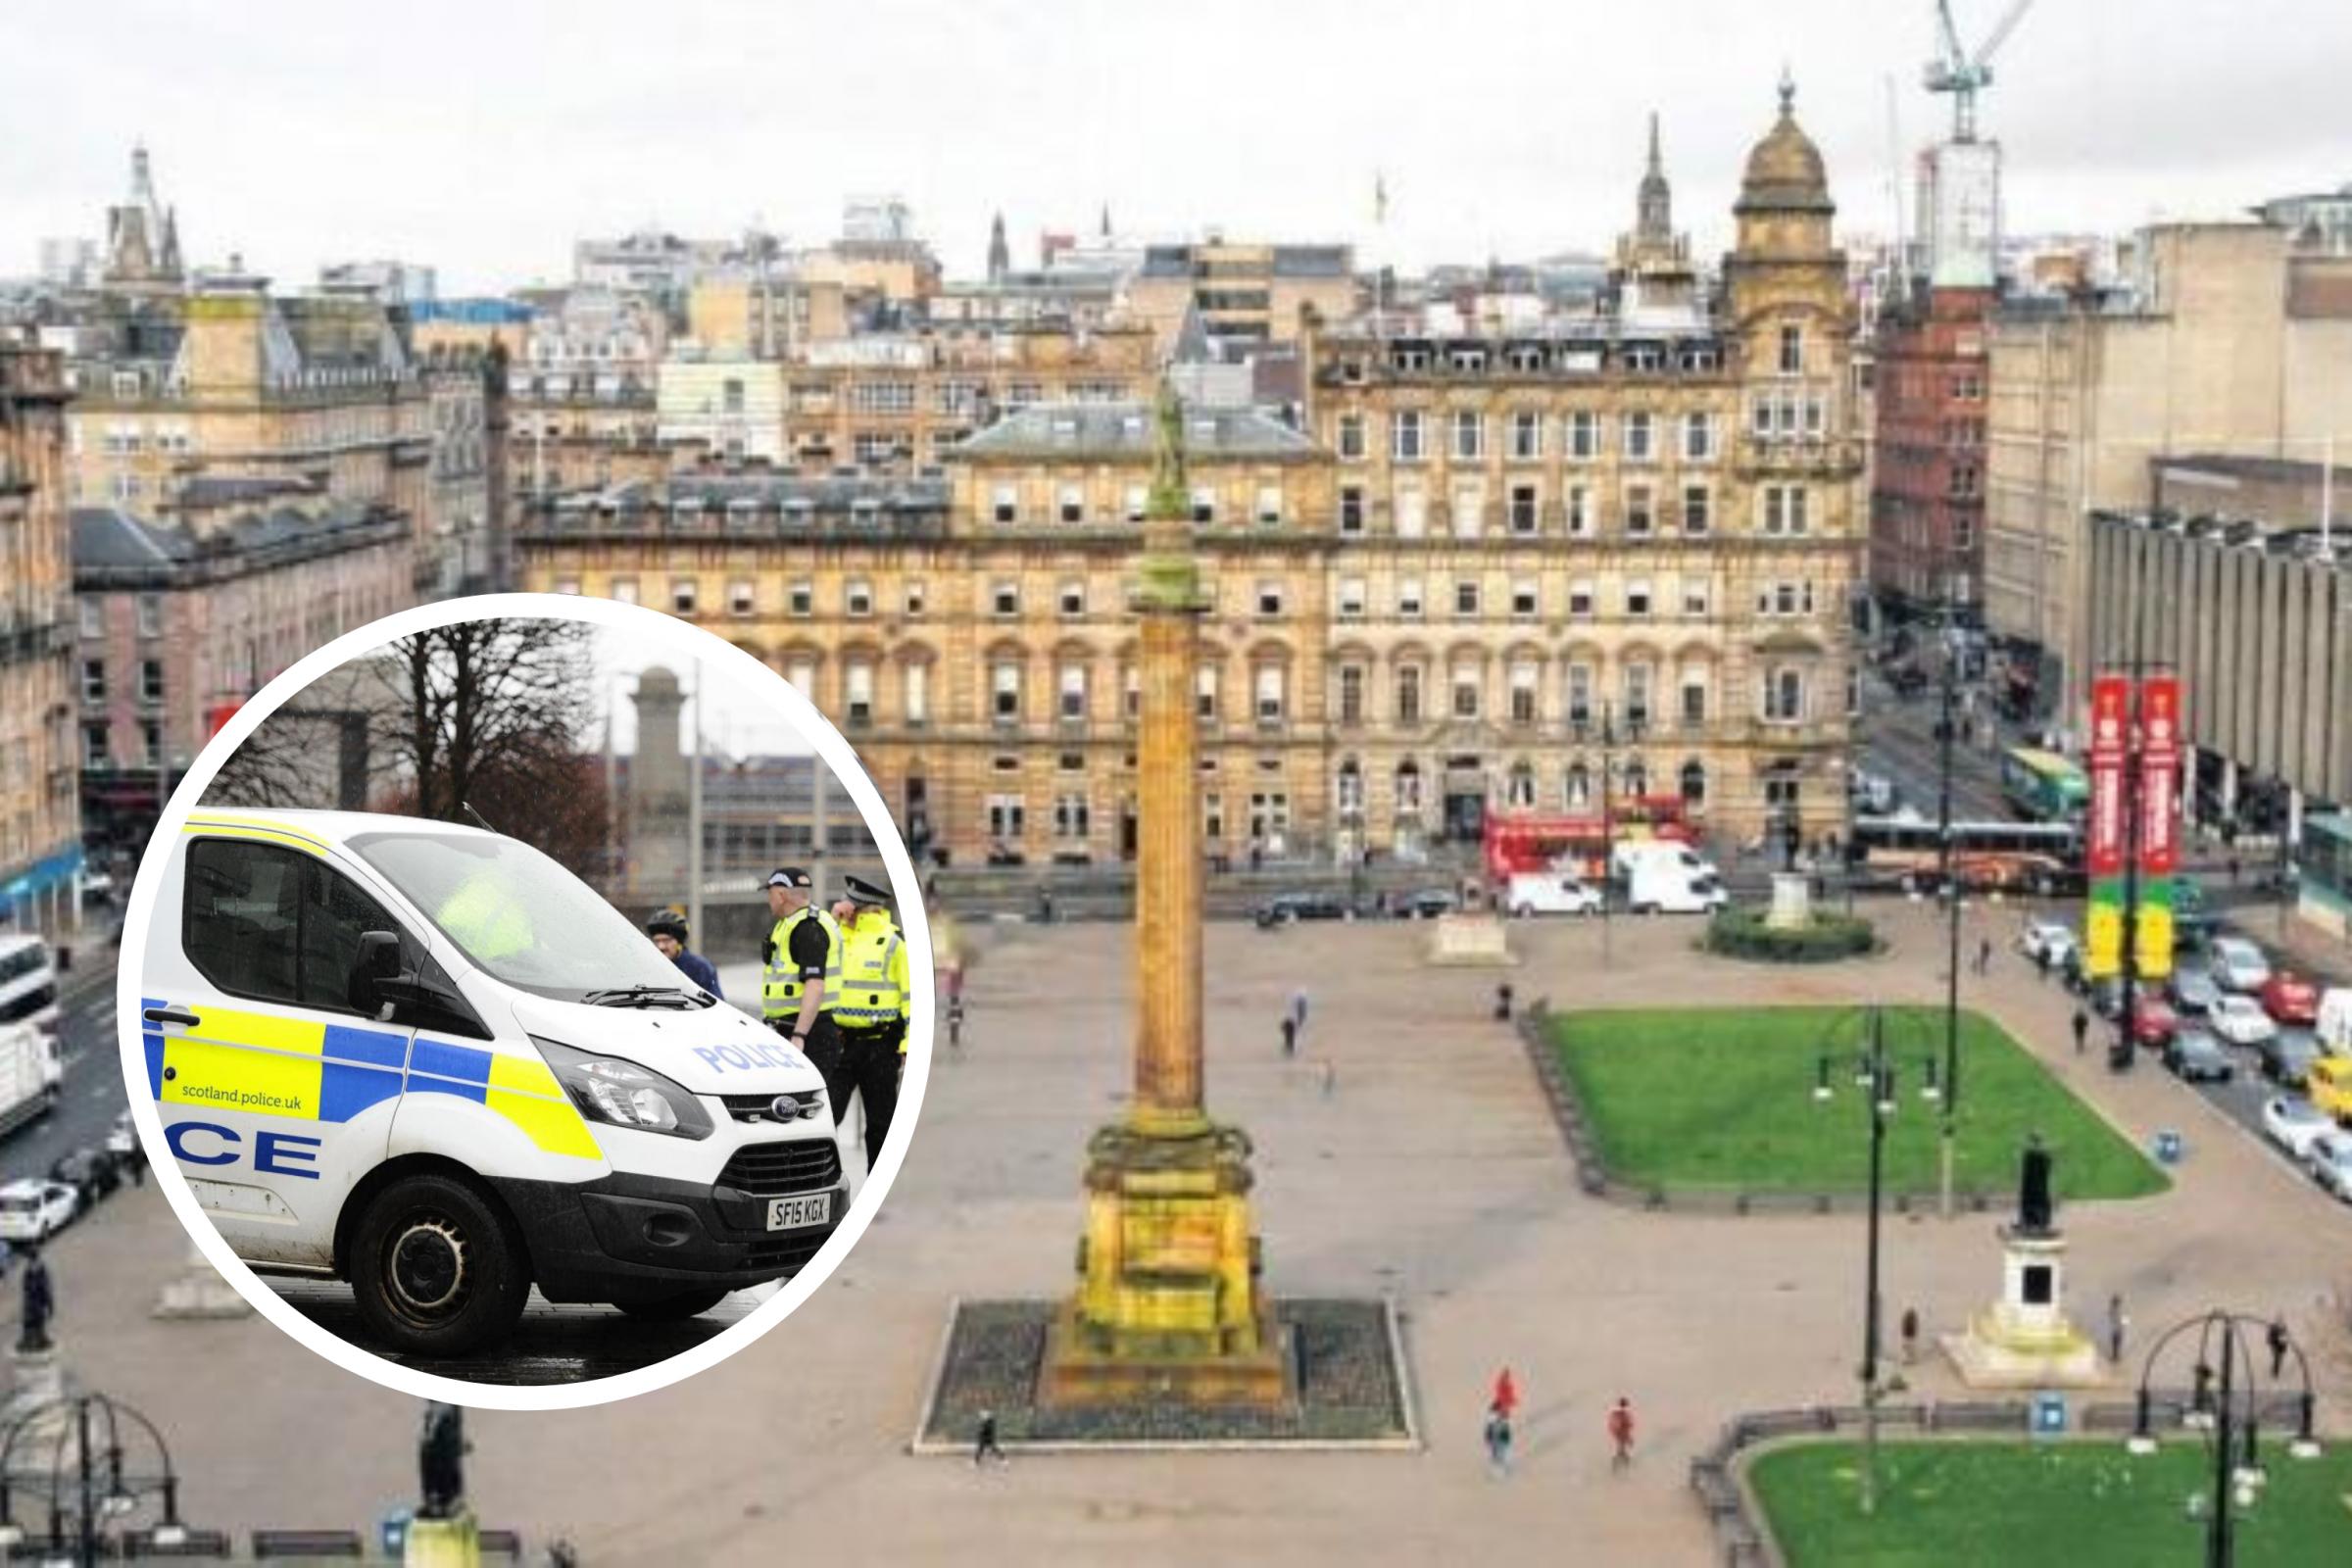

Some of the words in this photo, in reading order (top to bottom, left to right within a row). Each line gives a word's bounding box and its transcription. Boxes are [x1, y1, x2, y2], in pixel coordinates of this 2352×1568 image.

[692, 1044, 805, 1073] POLICE
[182, 1085, 301, 1109] scotland.police.uk
[775, 1200, 802, 1226] SF15
[804, 1198, 825, 1222] KGX
